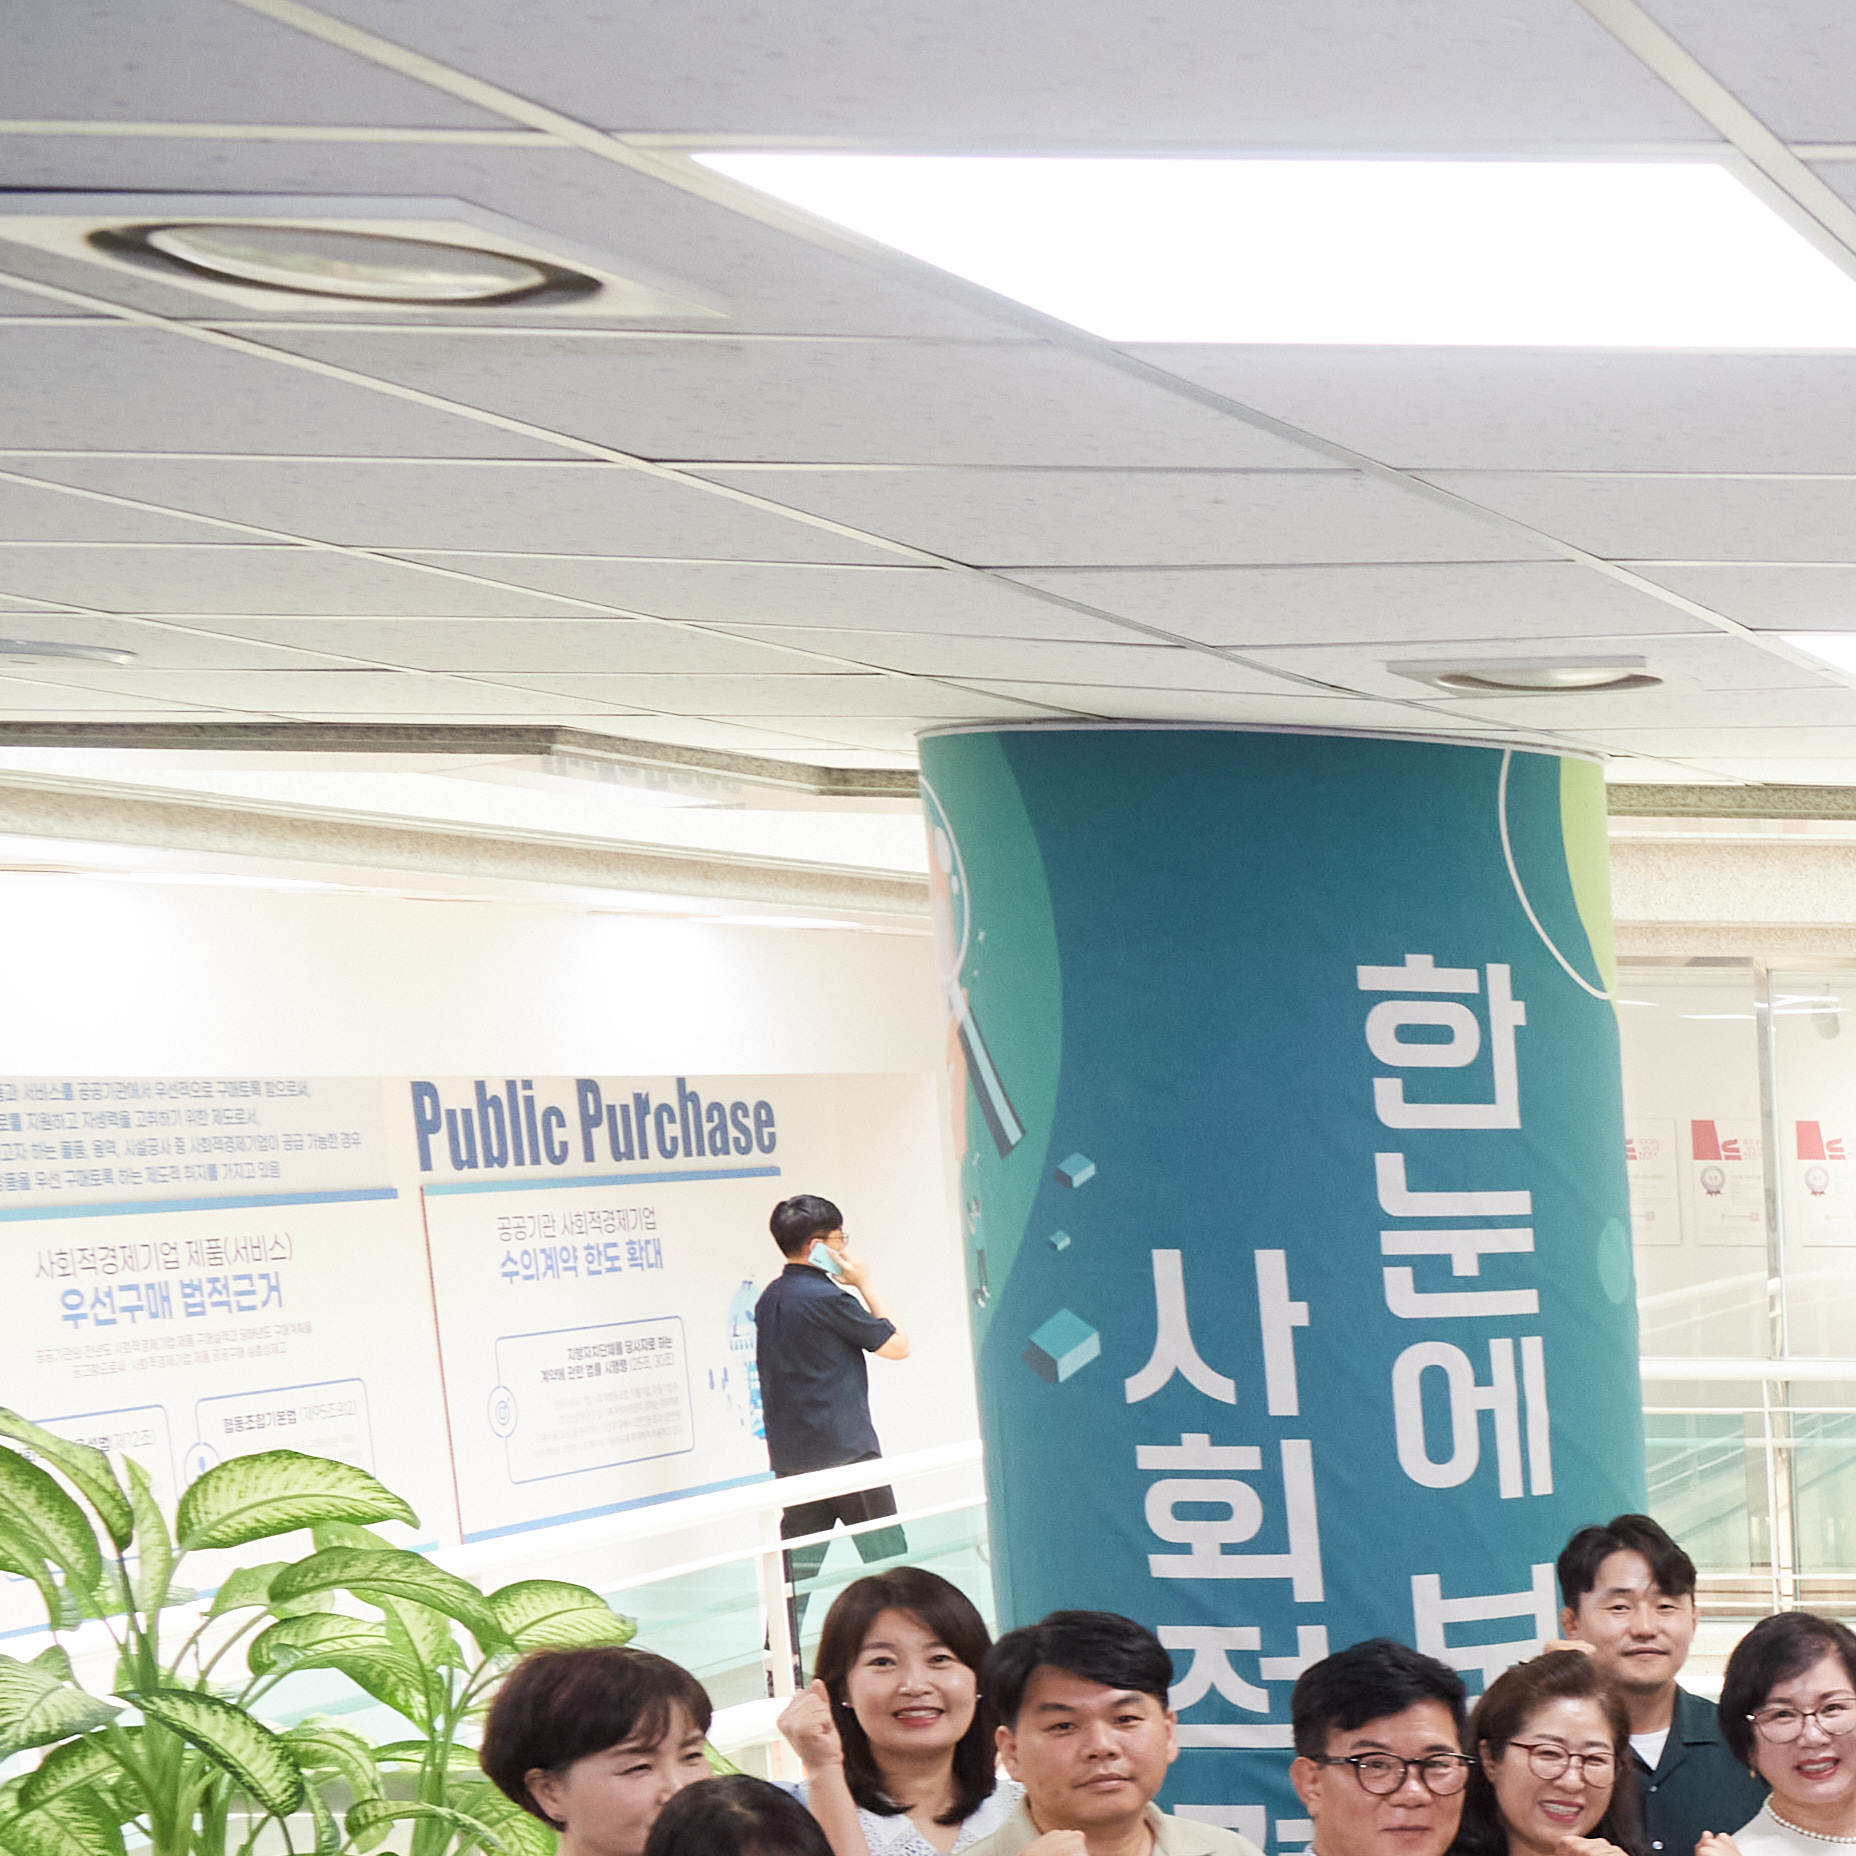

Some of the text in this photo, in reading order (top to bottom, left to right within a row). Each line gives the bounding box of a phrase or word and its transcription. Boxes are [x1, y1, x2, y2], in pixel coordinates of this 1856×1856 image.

[410, 1077, 777, 1172] Public Purchase
[497, 1205, 657, 1242] 공공기관 사회적경제기업
[1356, 953, 1553, 1500] 한눈에
[35, 1232, 294, 1279] 사회적경제기업 제품(서비스)
[500, 1237, 664, 1285] 수의계약 한도 확대
[60, 1271, 284, 1330] 우선구매 법적근거
